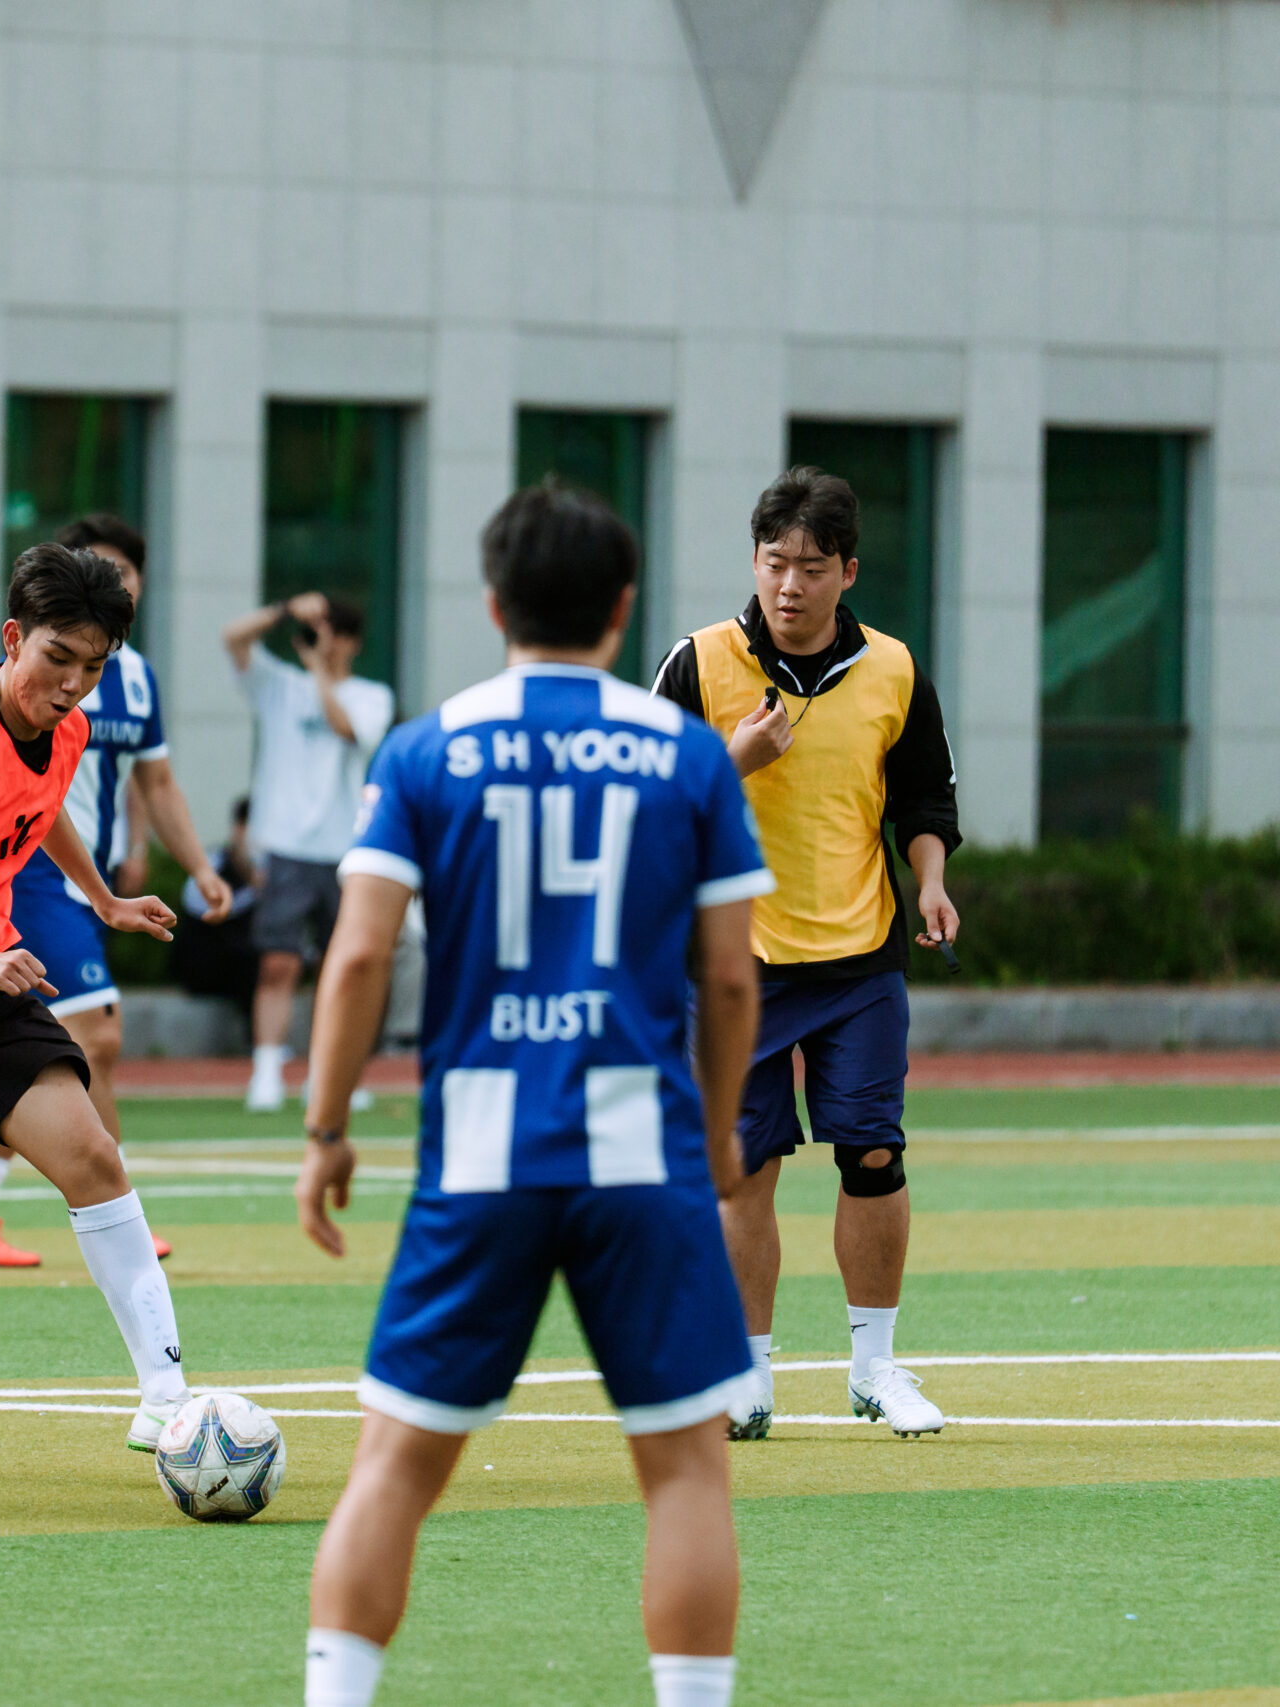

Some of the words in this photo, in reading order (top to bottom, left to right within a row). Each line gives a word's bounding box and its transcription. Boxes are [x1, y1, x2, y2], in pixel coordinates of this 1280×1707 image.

[447, 734, 484, 778] S
[493, 729, 531, 772] H
[542, 728, 677, 780] YOON
[484, 783, 639, 970] 14
[490, 990, 613, 1043] BUST
